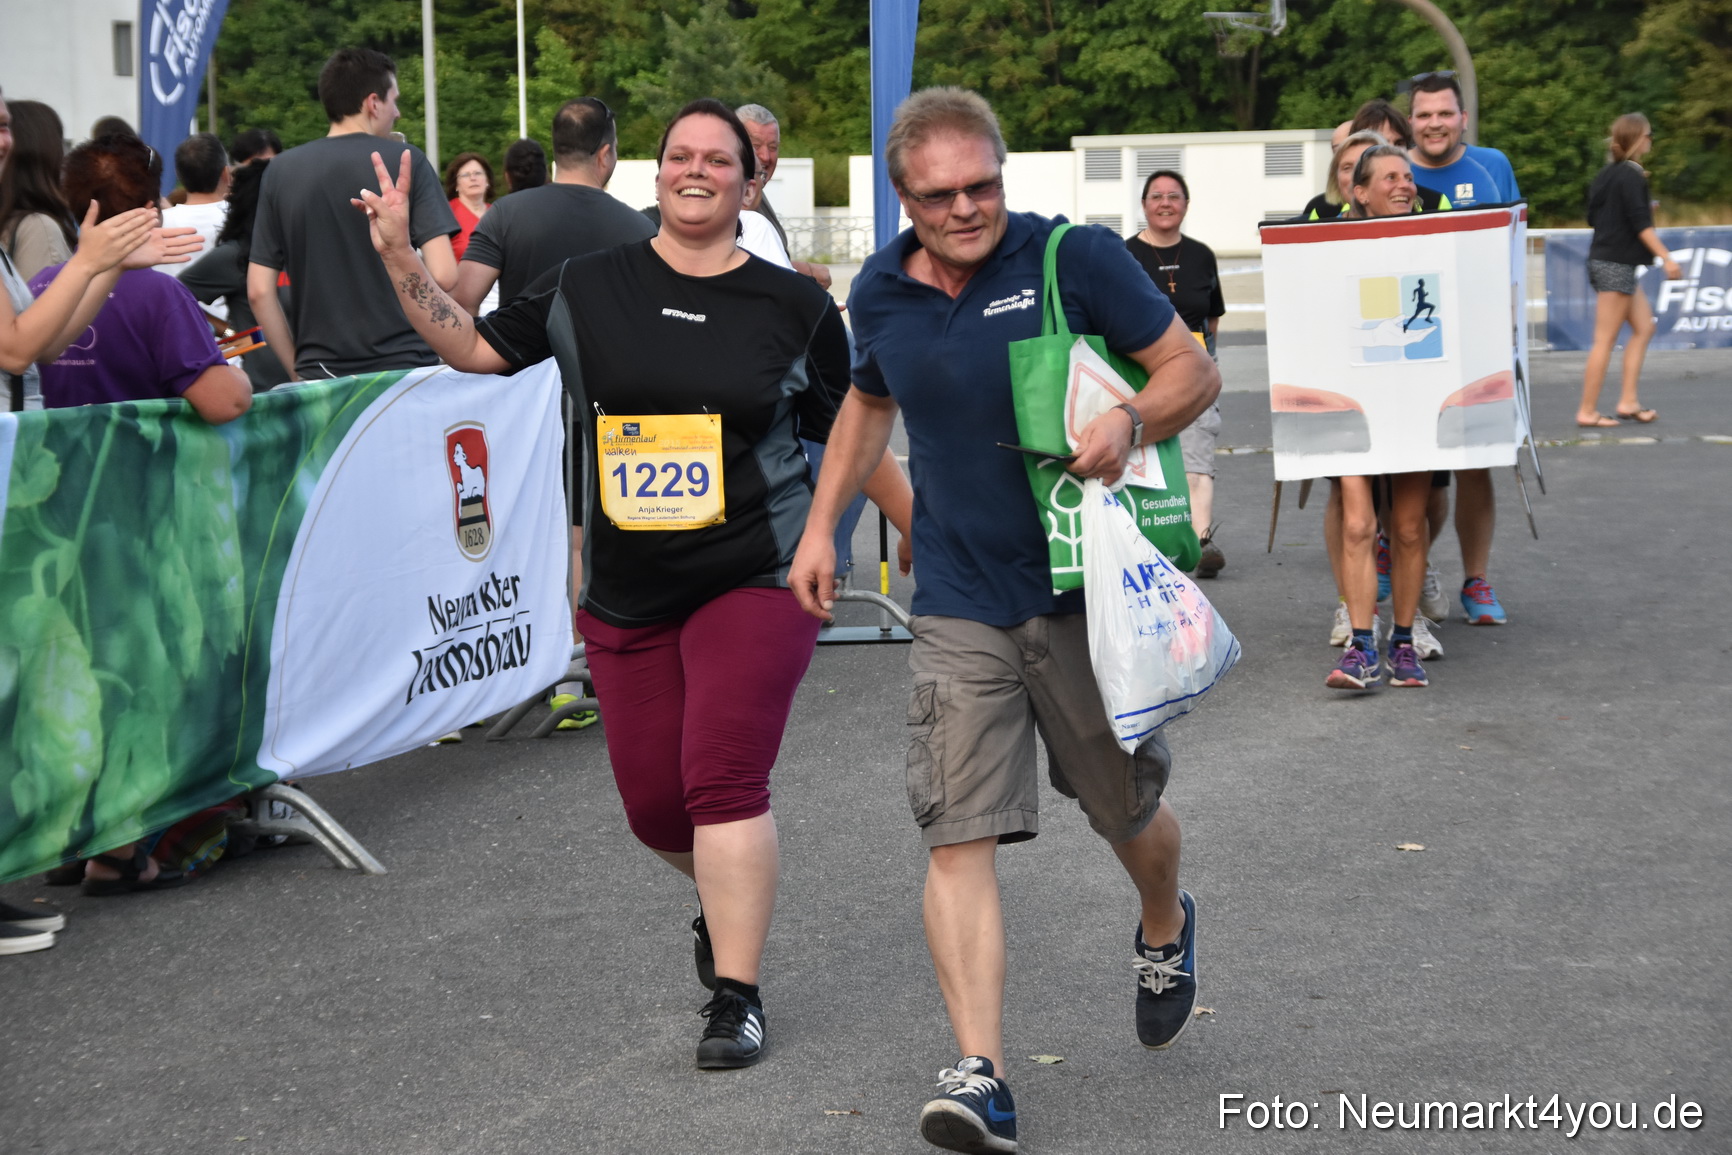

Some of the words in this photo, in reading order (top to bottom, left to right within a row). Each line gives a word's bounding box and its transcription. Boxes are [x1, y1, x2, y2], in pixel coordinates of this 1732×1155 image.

[983, 297, 1035, 317] Firmenstaffel
[615, 434, 657, 444] firmenlauf
[612, 461, 710, 498] 1229
[638, 506, 655, 514] Anja
[656, 506, 684, 514] Krieger
[1141, 495, 1188, 510] Gesundheit
[1141, 515, 1151, 527] in
[1153, 513, 1183, 526] besten
[464, 527, 485, 548] 1628
